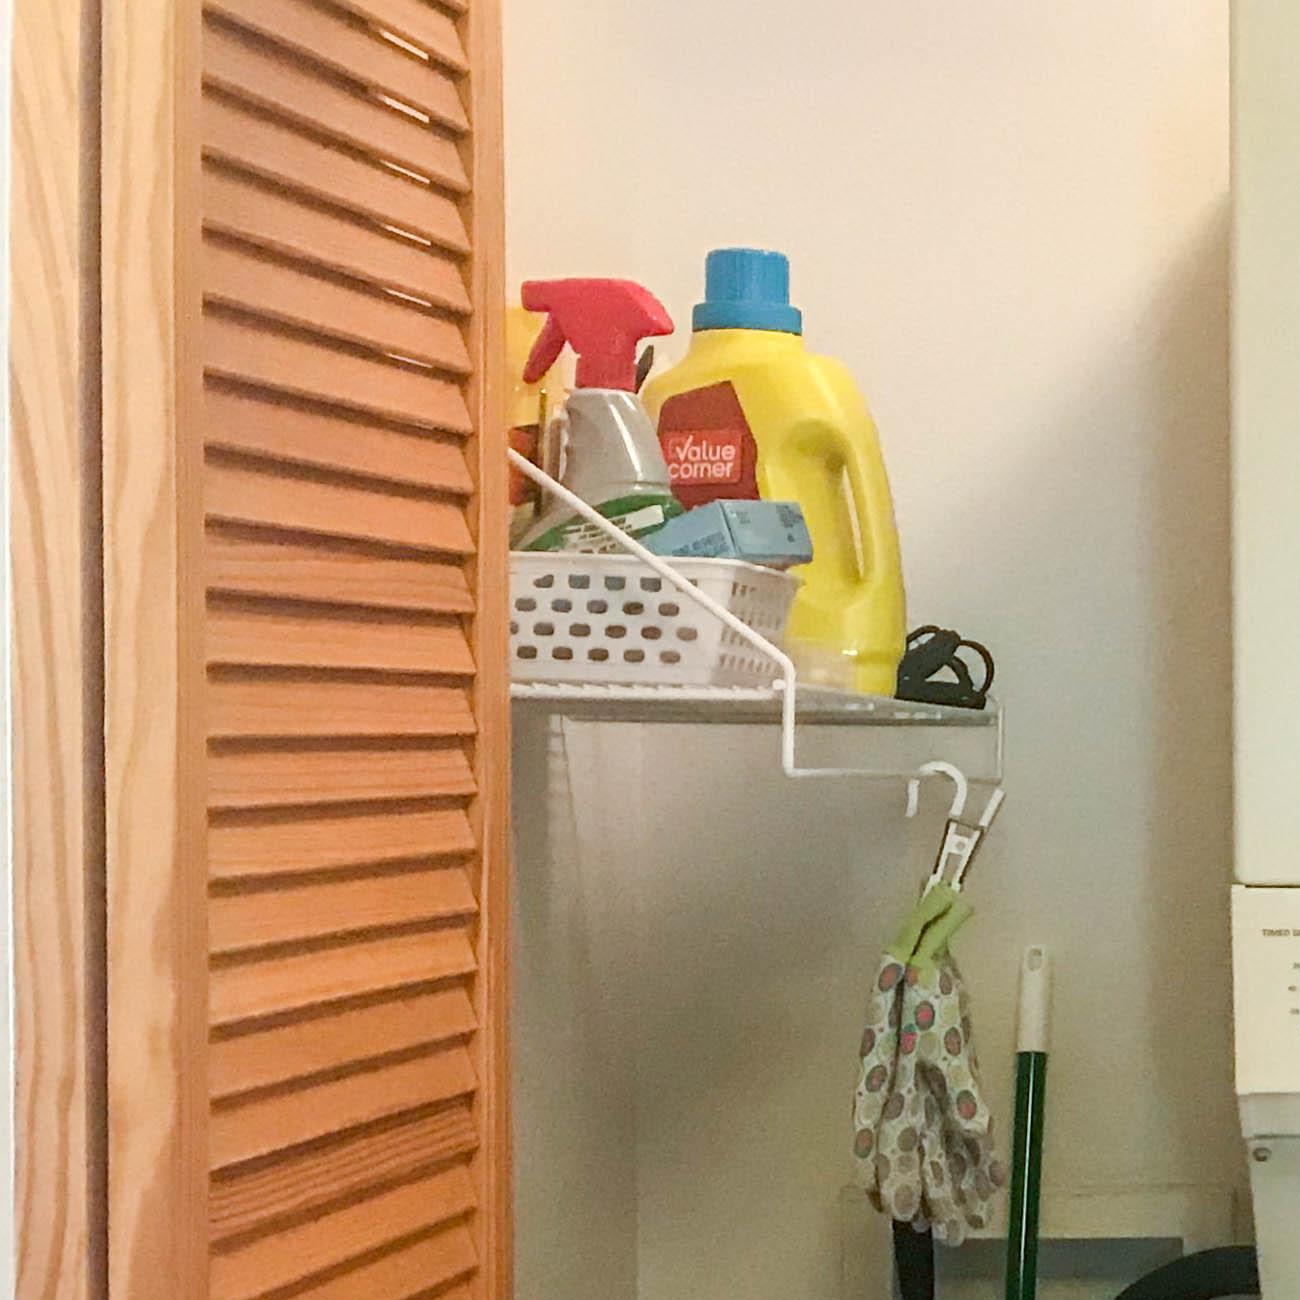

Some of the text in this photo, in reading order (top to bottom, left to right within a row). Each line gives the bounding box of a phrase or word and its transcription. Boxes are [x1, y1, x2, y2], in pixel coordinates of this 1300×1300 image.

[674, 435, 736, 461] value
[668, 461, 734, 479] corner
[1261, 928, 1291, 937] TIMED
